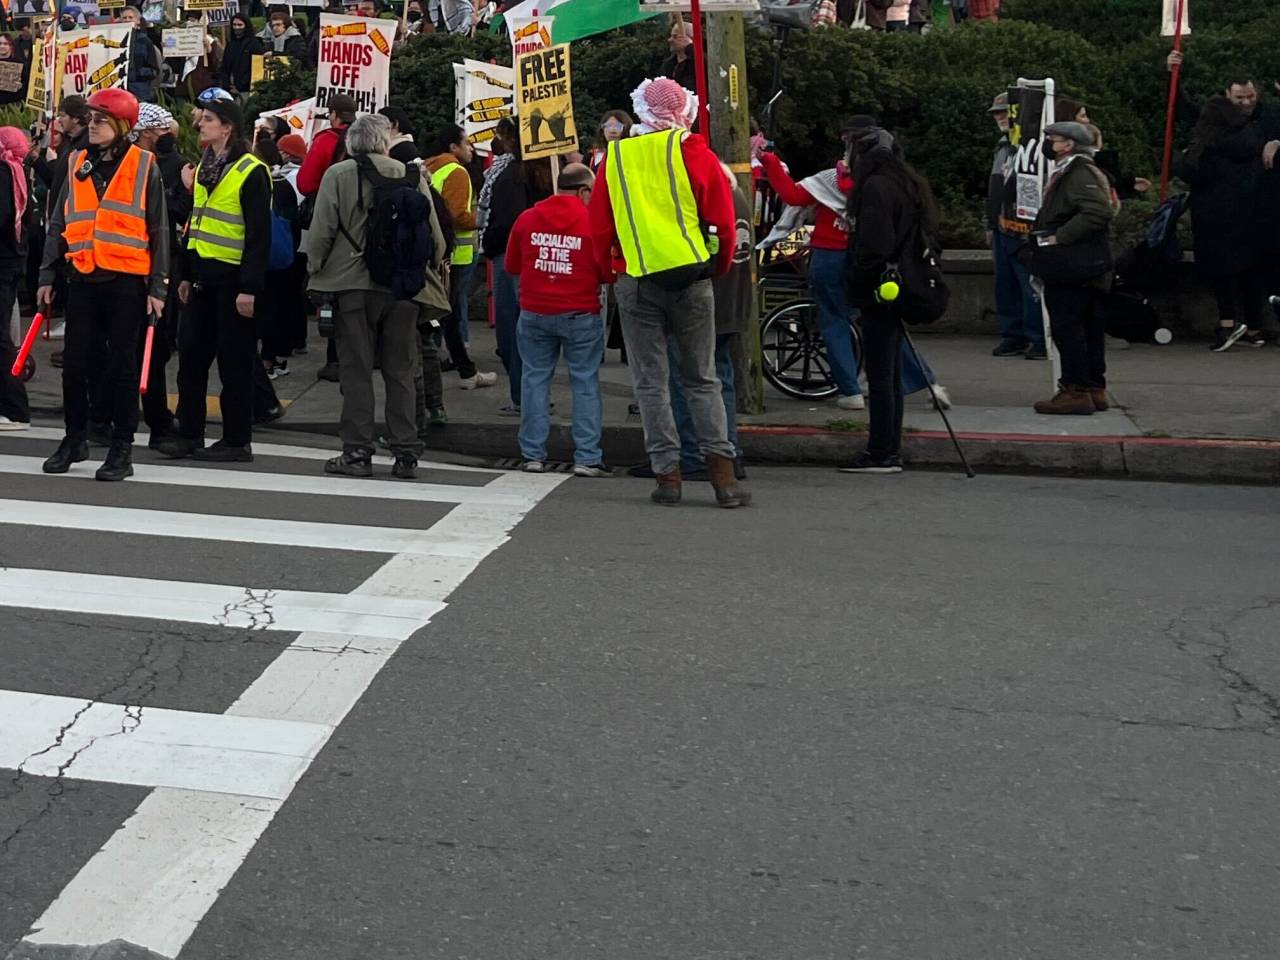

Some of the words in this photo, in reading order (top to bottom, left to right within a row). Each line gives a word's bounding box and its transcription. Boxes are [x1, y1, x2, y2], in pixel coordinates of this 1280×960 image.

[208, 8, 239, 22] NOW!
[65, 52, 88, 74] HAN
[321, 40, 373, 67] HANDS
[330, 64, 360, 88] OFF
[521, 47, 566, 87] FREE
[316, 86, 371, 113] RAH!
[522, 80, 567, 104] PALESTINE
[530, 232, 582, 251] SOCIALISM
[539, 246, 549, 260] IS
[551, 247, 570, 262] THE
[534, 258, 573, 275] FUTURE
